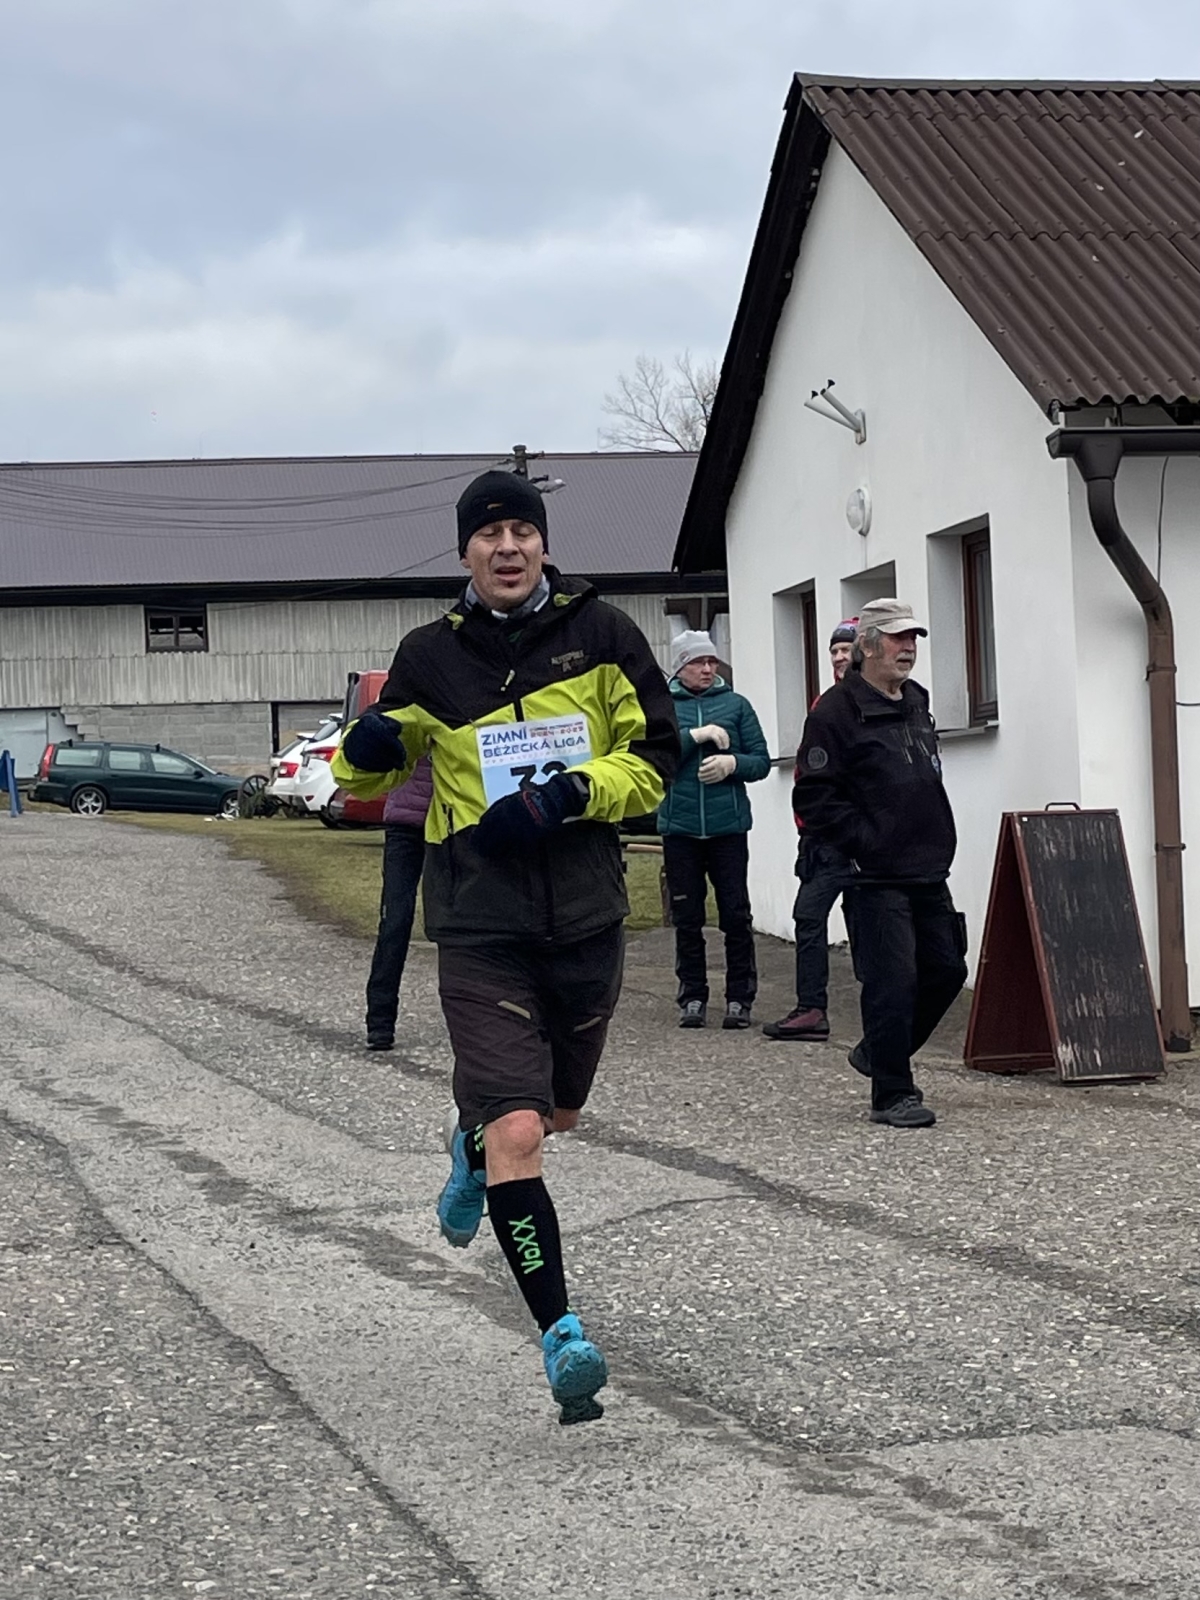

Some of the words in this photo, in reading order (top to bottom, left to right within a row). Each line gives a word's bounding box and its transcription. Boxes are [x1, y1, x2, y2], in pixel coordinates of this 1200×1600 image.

[482, 727, 526, 745] ZIMNÍ
[554, 736, 585, 749] LIGA
[508, 1215, 544, 1274] VOXX
